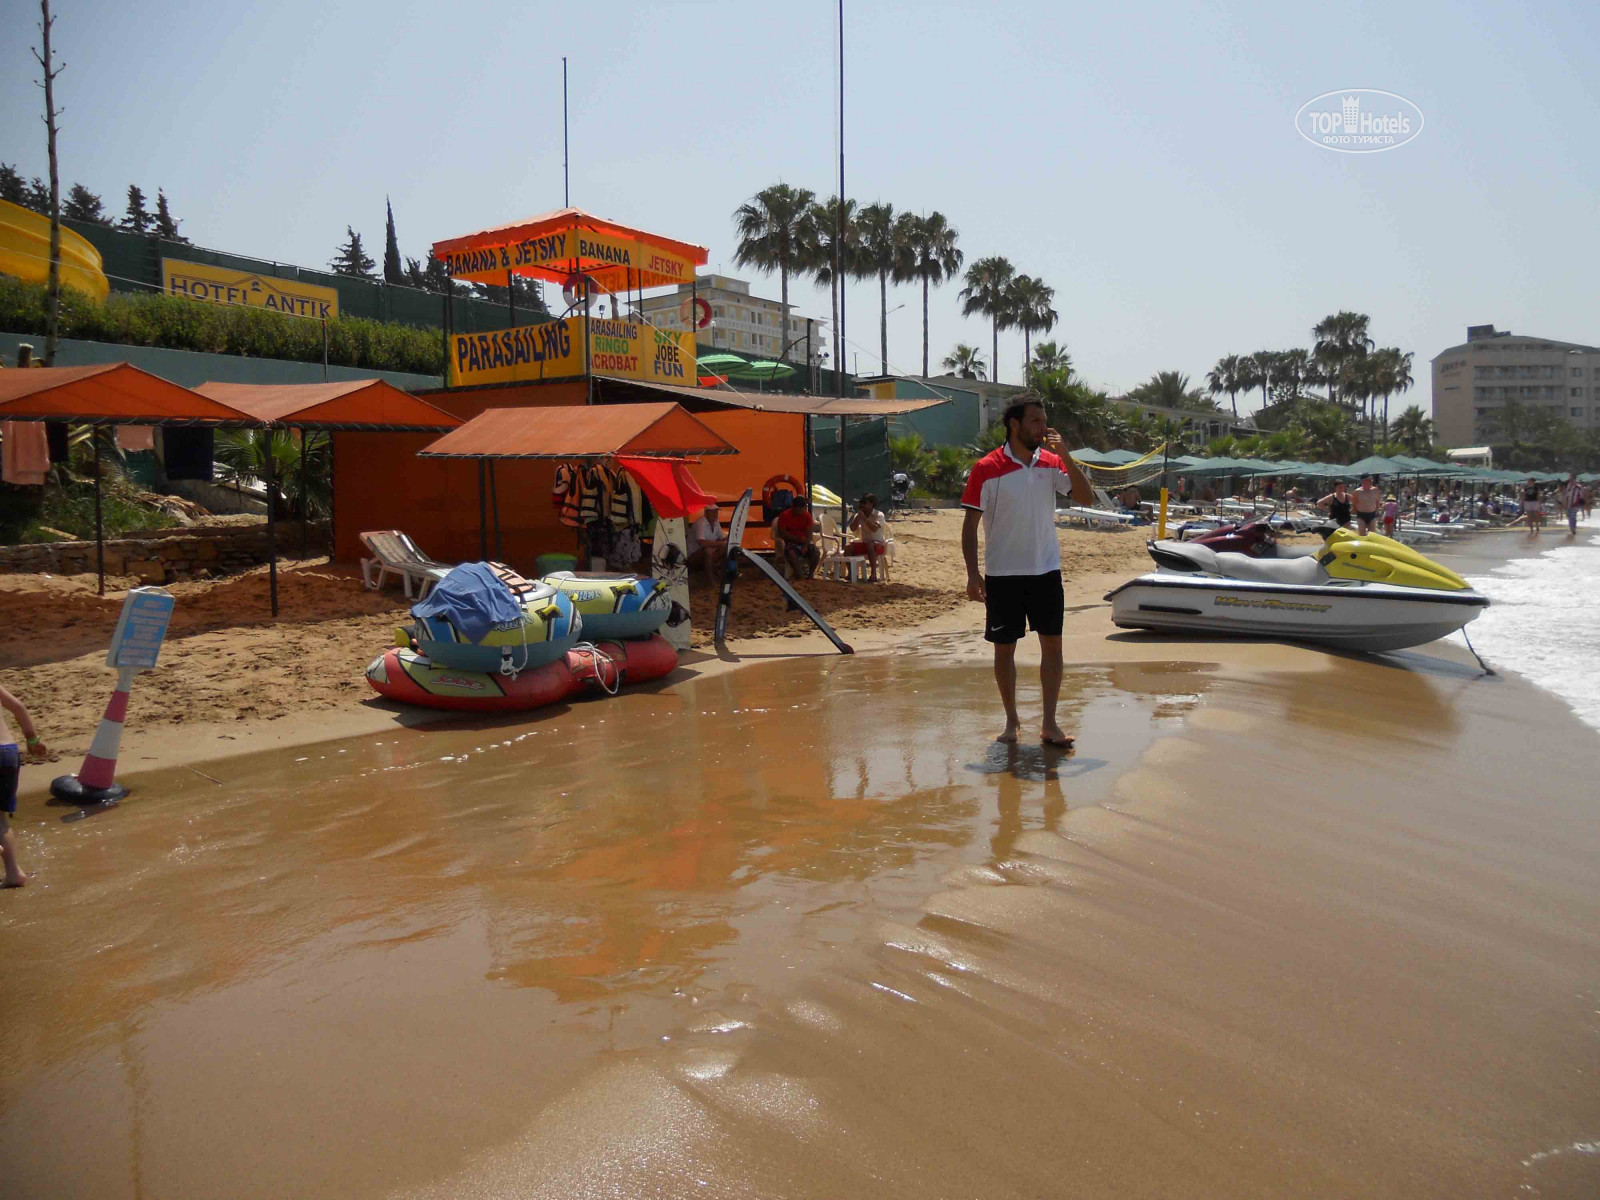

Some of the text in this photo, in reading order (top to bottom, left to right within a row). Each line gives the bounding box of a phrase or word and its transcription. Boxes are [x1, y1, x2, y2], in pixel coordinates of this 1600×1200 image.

[446, 233, 566, 277] BANANA & JETSKY
[580, 239, 631, 266] BANANA
[649, 255, 684, 277] JETSKY
[265, 293, 332, 321] ANTIK
[591, 319, 637, 340] ARASAILING
[654, 330, 682, 346] SKY
[457, 320, 571, 373] PARASAILING
[655, 345, 680, 363] JOBE
[654, 360, 685, 378] FUN
